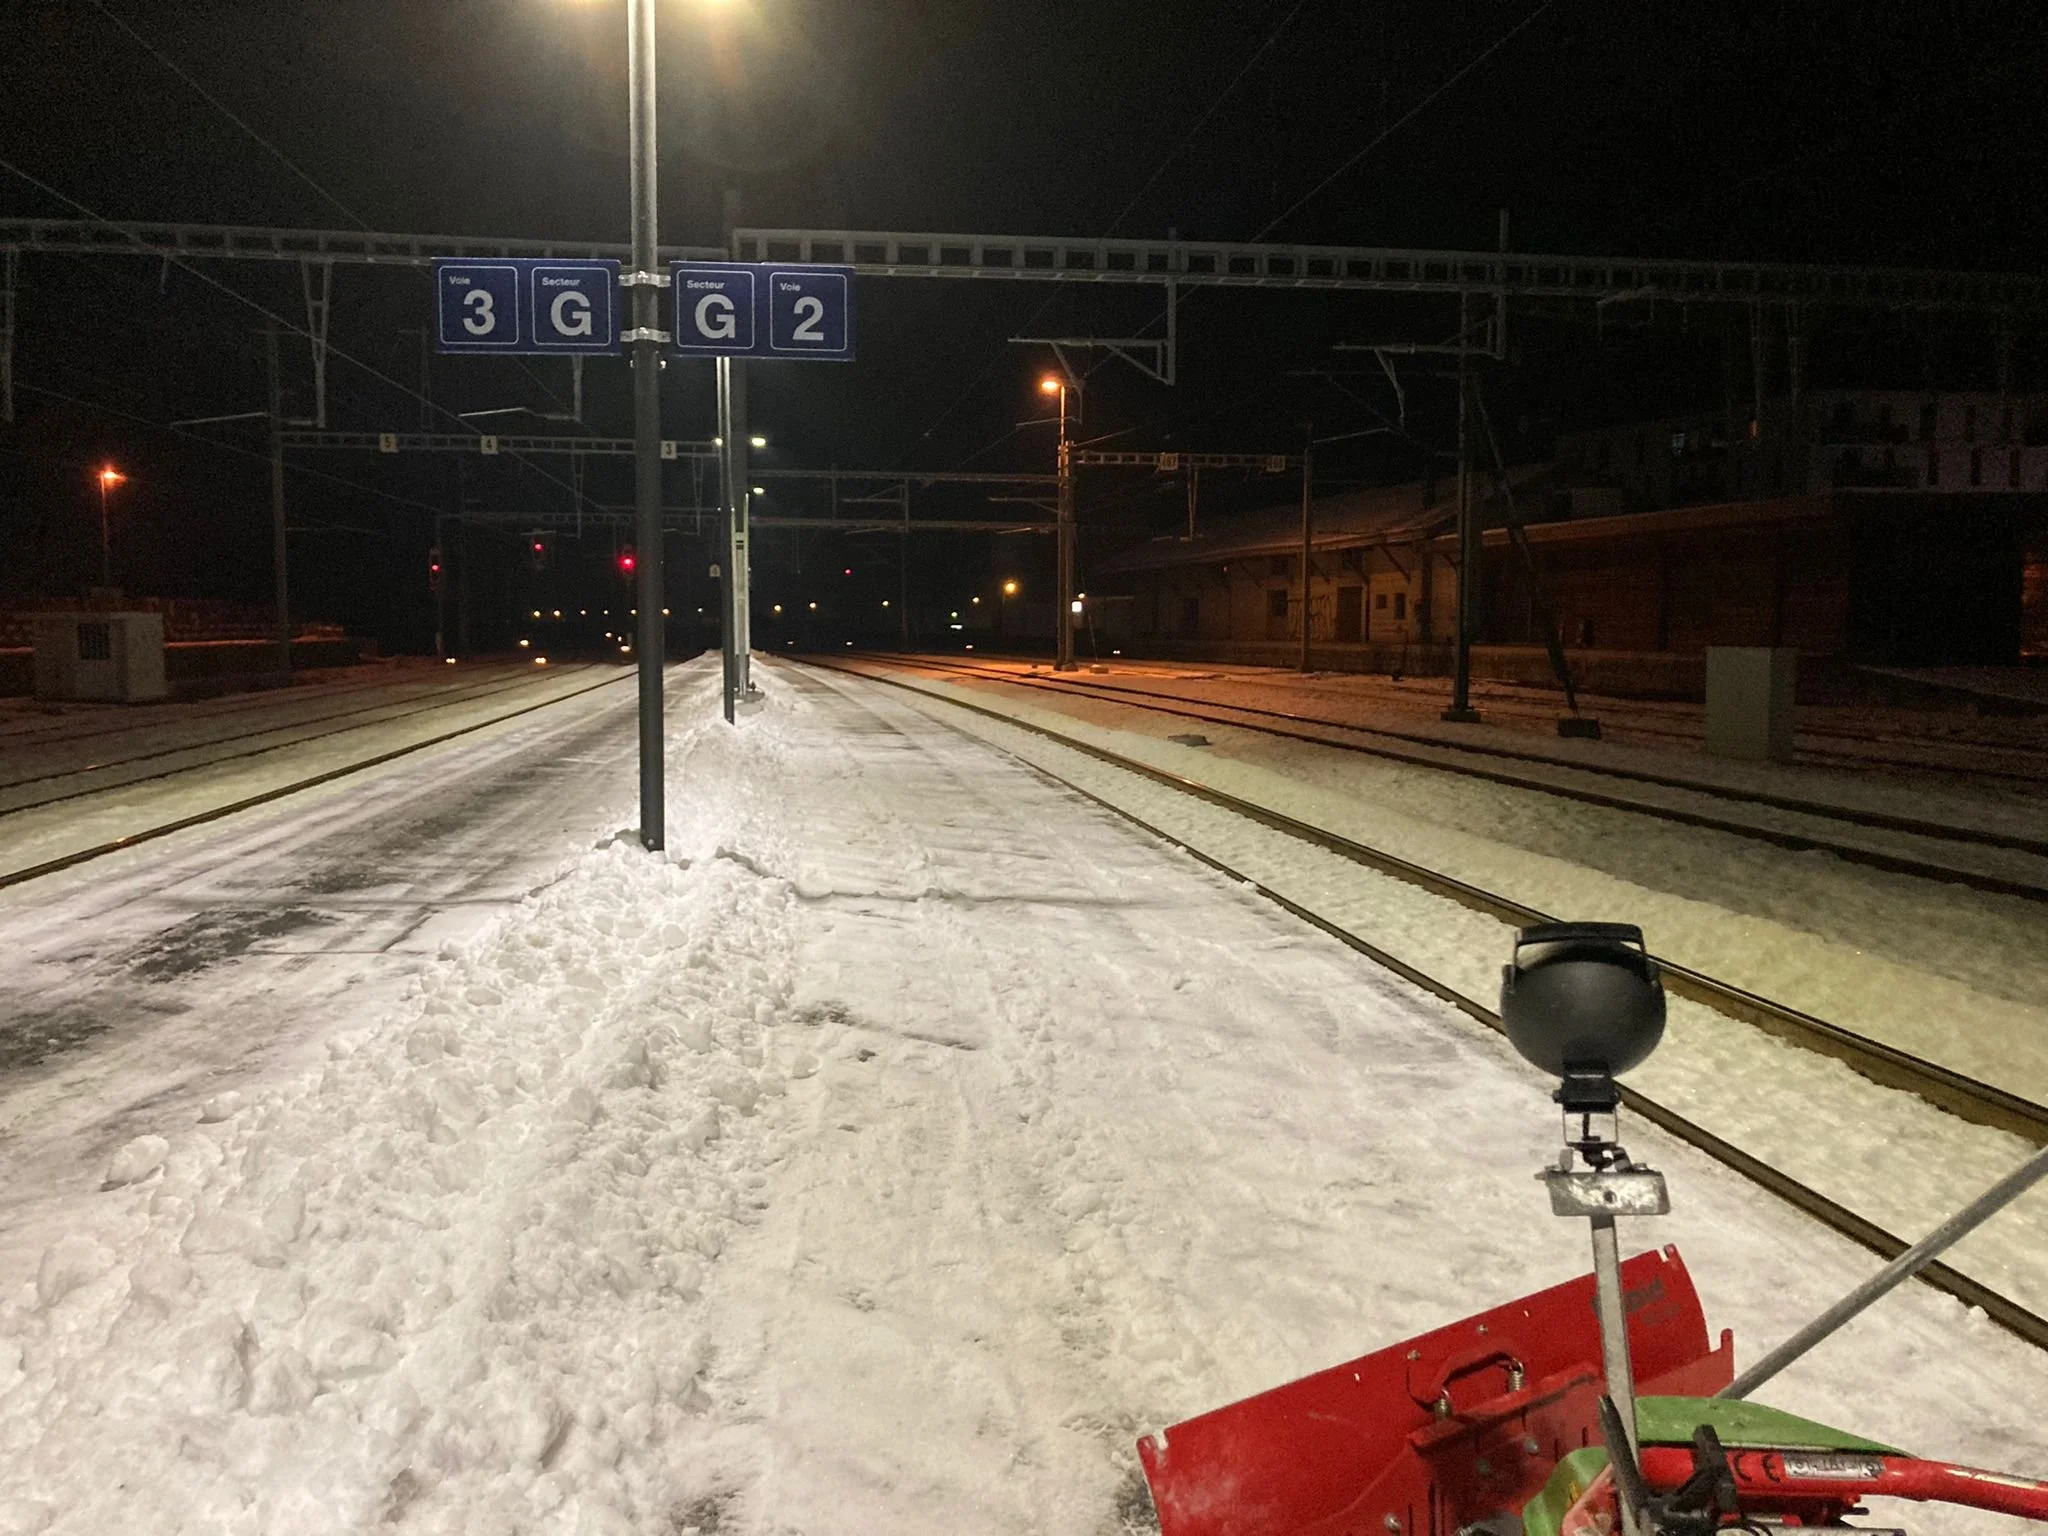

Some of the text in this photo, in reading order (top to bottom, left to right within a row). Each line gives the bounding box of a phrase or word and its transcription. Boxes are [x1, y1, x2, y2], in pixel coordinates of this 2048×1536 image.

[449, 276, 471, 285] Voie
[542, 277, 581, 286] Secteur
[687, 280, 725, 289] Secteur
[780, 282, 801, 292] Voie
[463, 289, 496, 336] 3
[551, 291, 592, 336] G
[695, 293, 736, 339] G
[793, 296, 824, 341] 2
